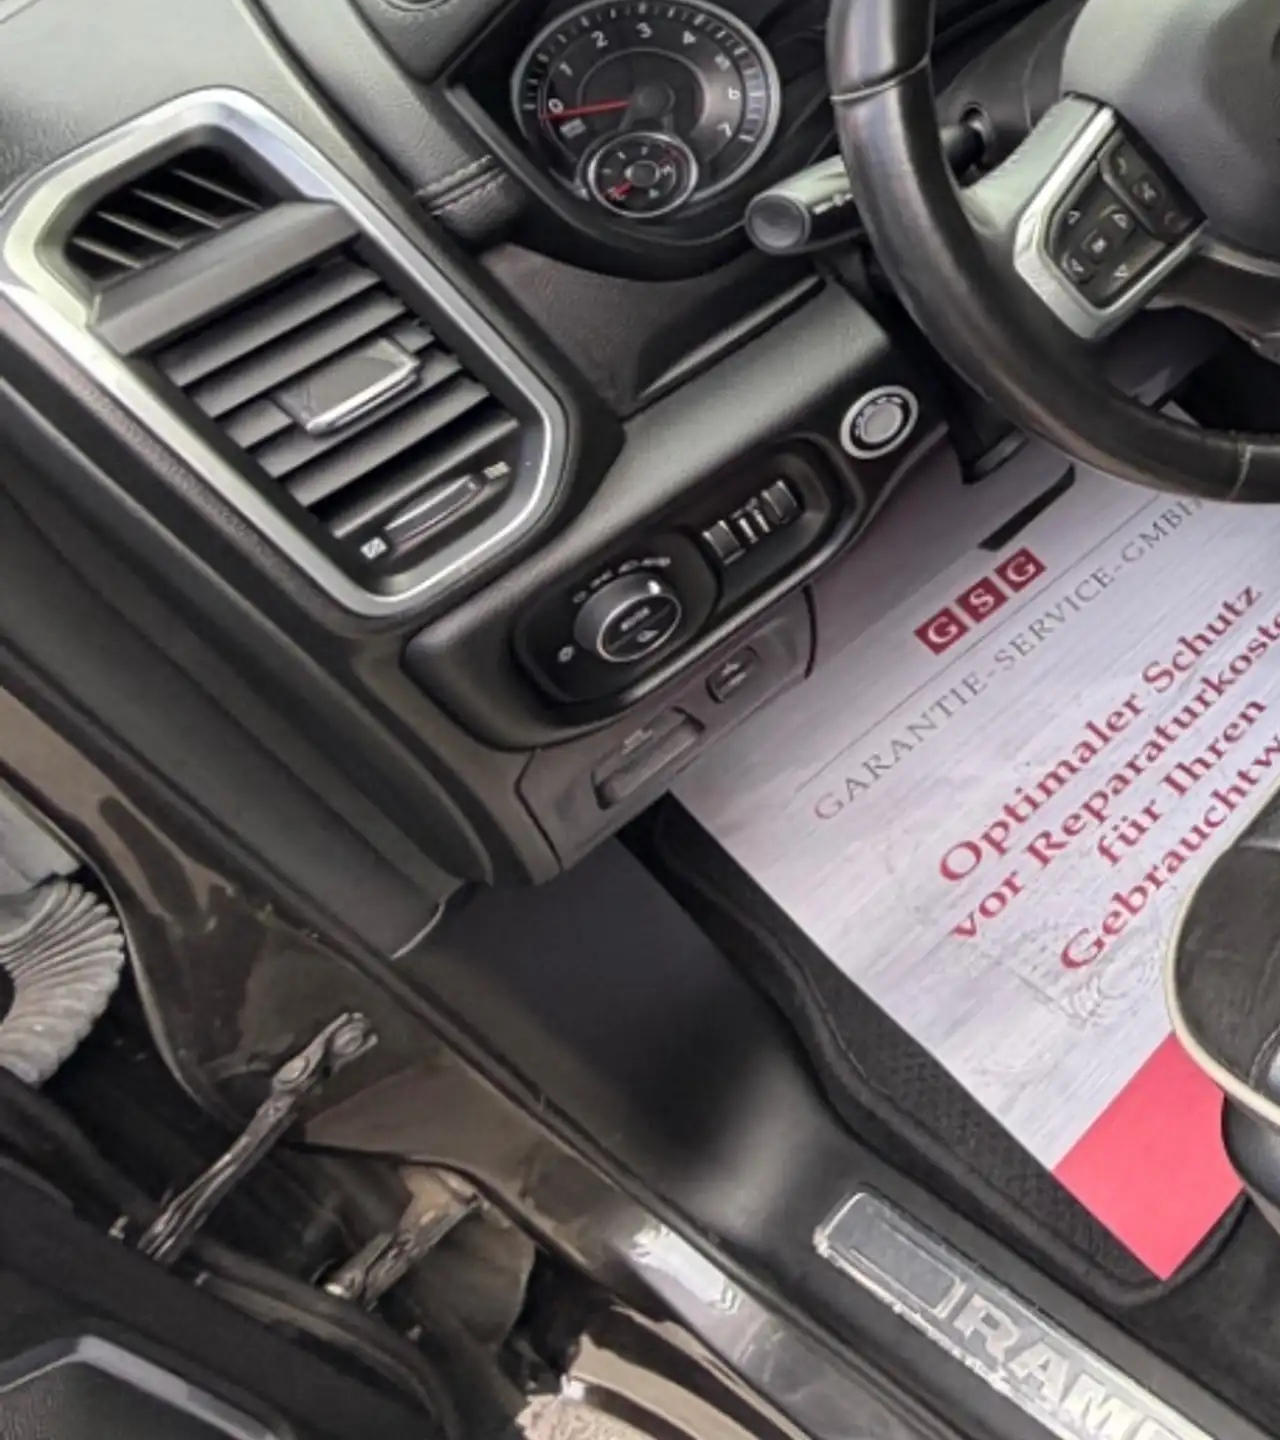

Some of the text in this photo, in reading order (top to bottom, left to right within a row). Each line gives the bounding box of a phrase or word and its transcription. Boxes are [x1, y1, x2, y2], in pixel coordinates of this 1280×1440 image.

[590, 30, 609, 49] 2
[634, 21, 654, 39] 3
[914, 547, 1047, 655] GSG
[938, 584, 1264, 883] Optimaler Schutz
[1096, 697, 1269, 868] für Ihren
[951, 871, 1025, 941] vor
